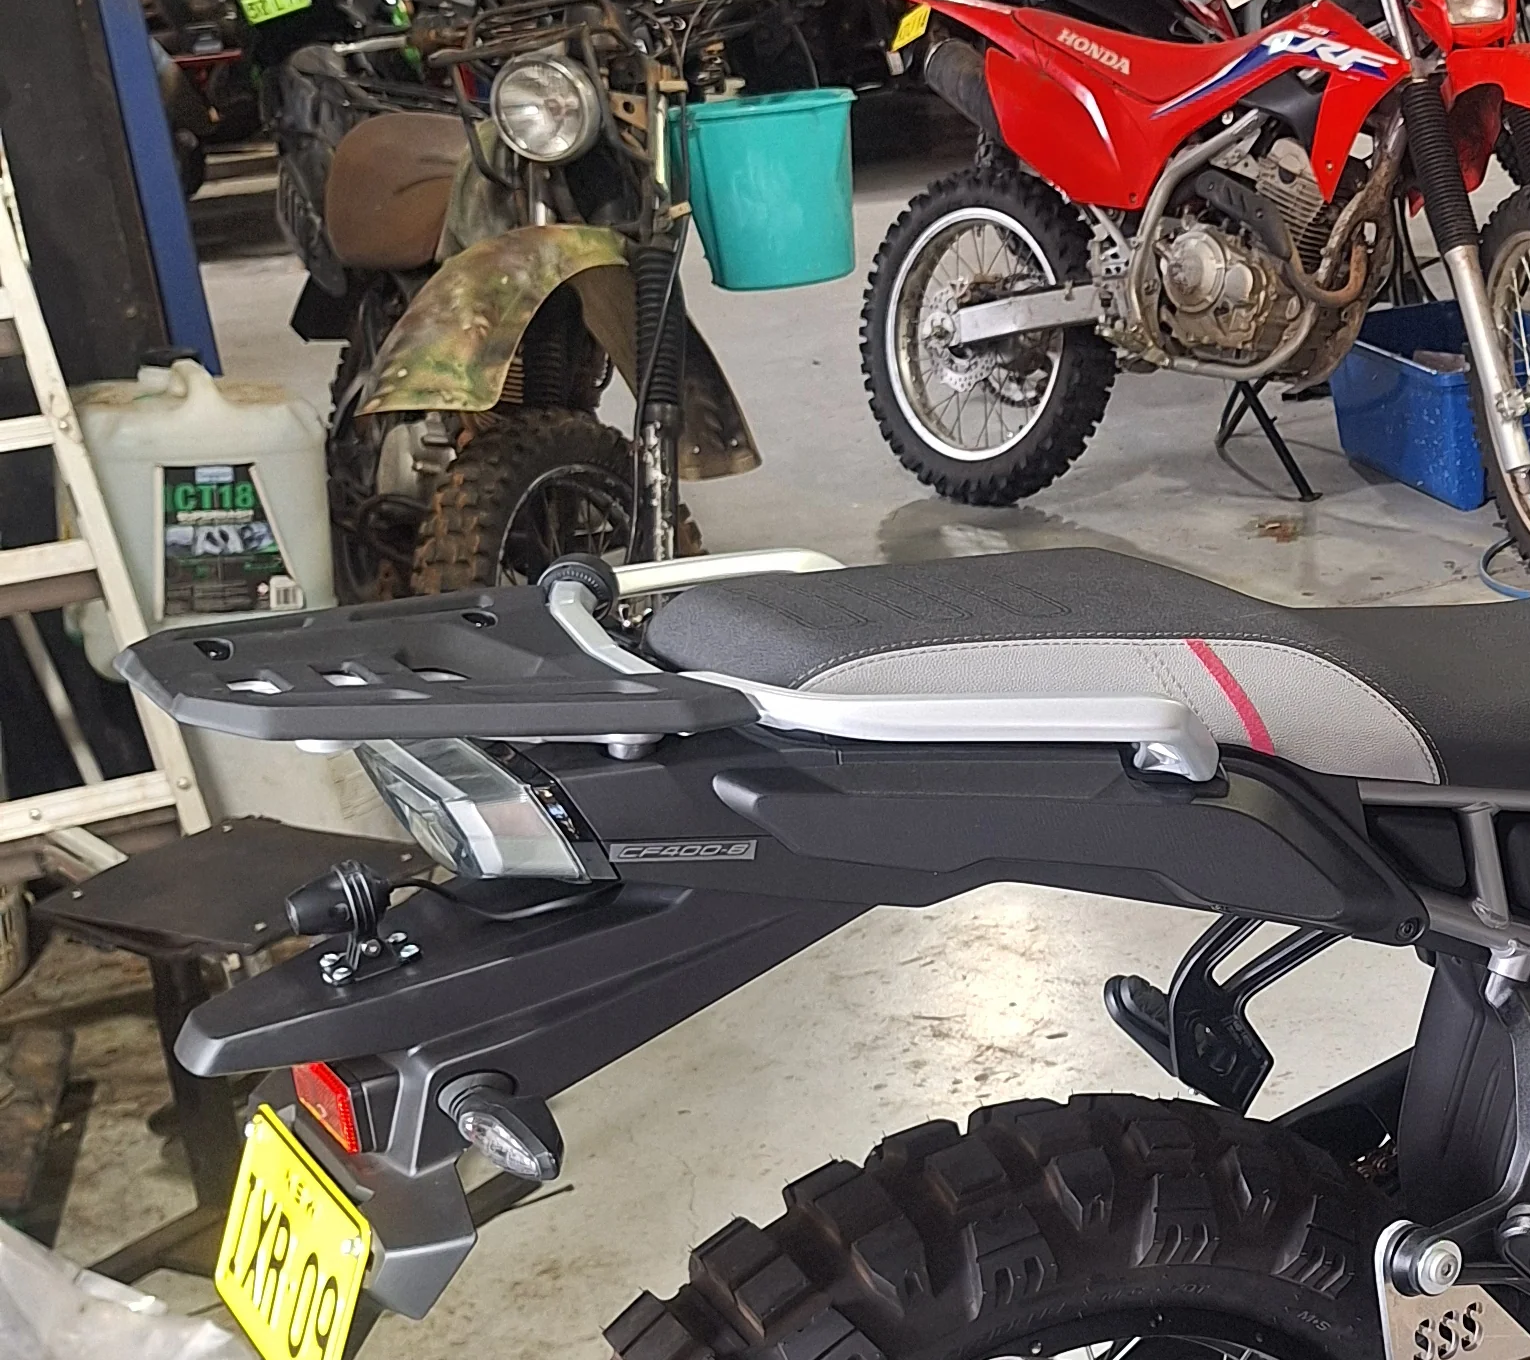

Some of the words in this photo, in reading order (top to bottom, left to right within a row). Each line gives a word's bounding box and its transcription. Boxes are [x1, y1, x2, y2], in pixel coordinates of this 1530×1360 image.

[1056, 27, 1131, 76] HONDA
[1261, 29, 1400, 72] CRF
[173, 482, 255, 511] CT18
